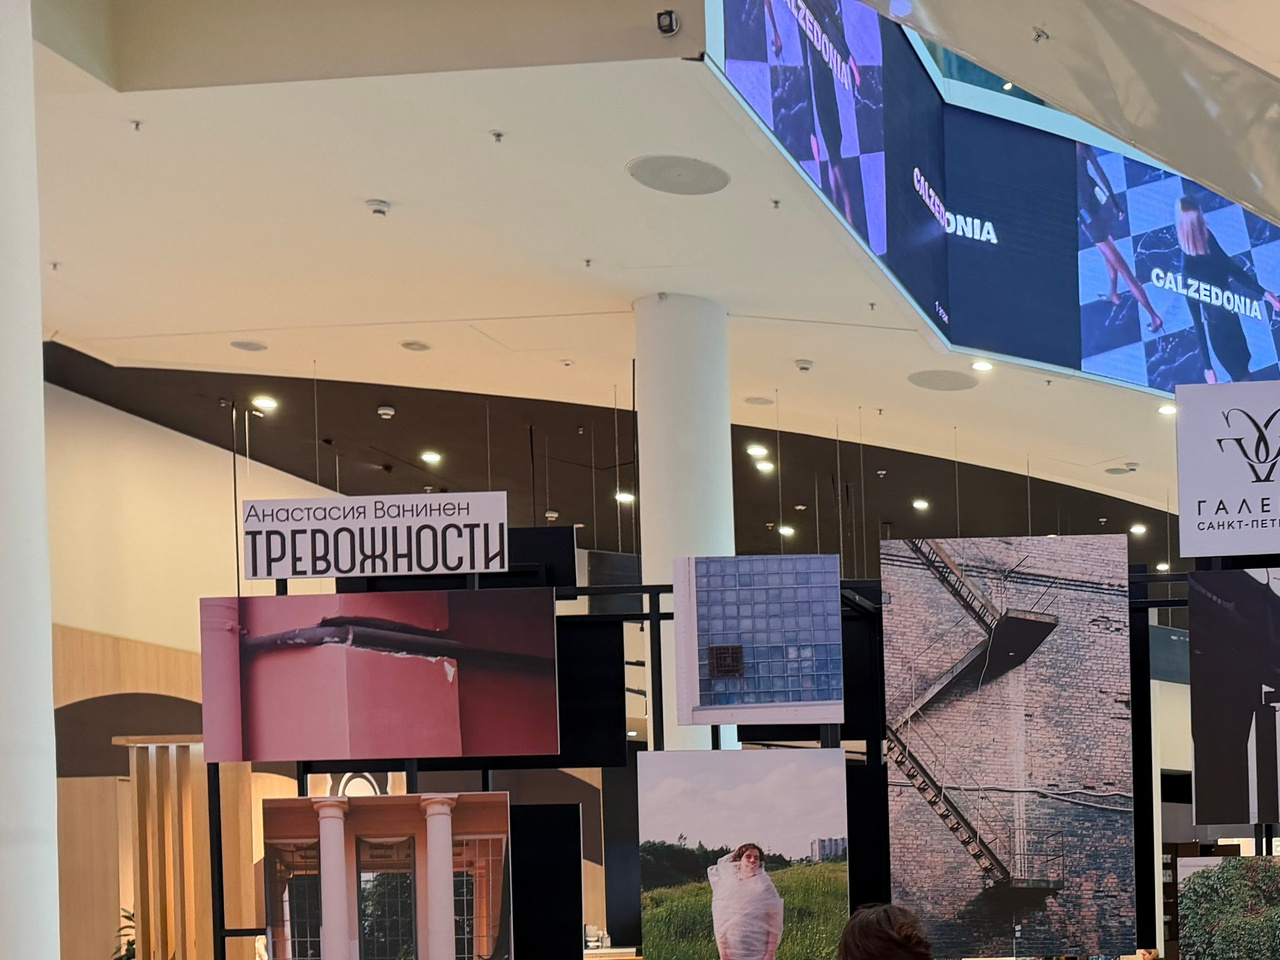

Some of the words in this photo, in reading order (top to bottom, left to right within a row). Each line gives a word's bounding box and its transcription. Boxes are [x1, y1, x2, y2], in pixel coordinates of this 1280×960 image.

[784, 0, 850, 91] LZEDONIA
[913, 167, 999, 244] CALZEDONIA
[1151, 267, 1262, 320] CALZEDONIA
[244, 503, 367, 523] Анастасия
[374, 500, 471, 518] Ванинен
[244, 521, 506, 578] ТРЕВОЖНОСТИ
